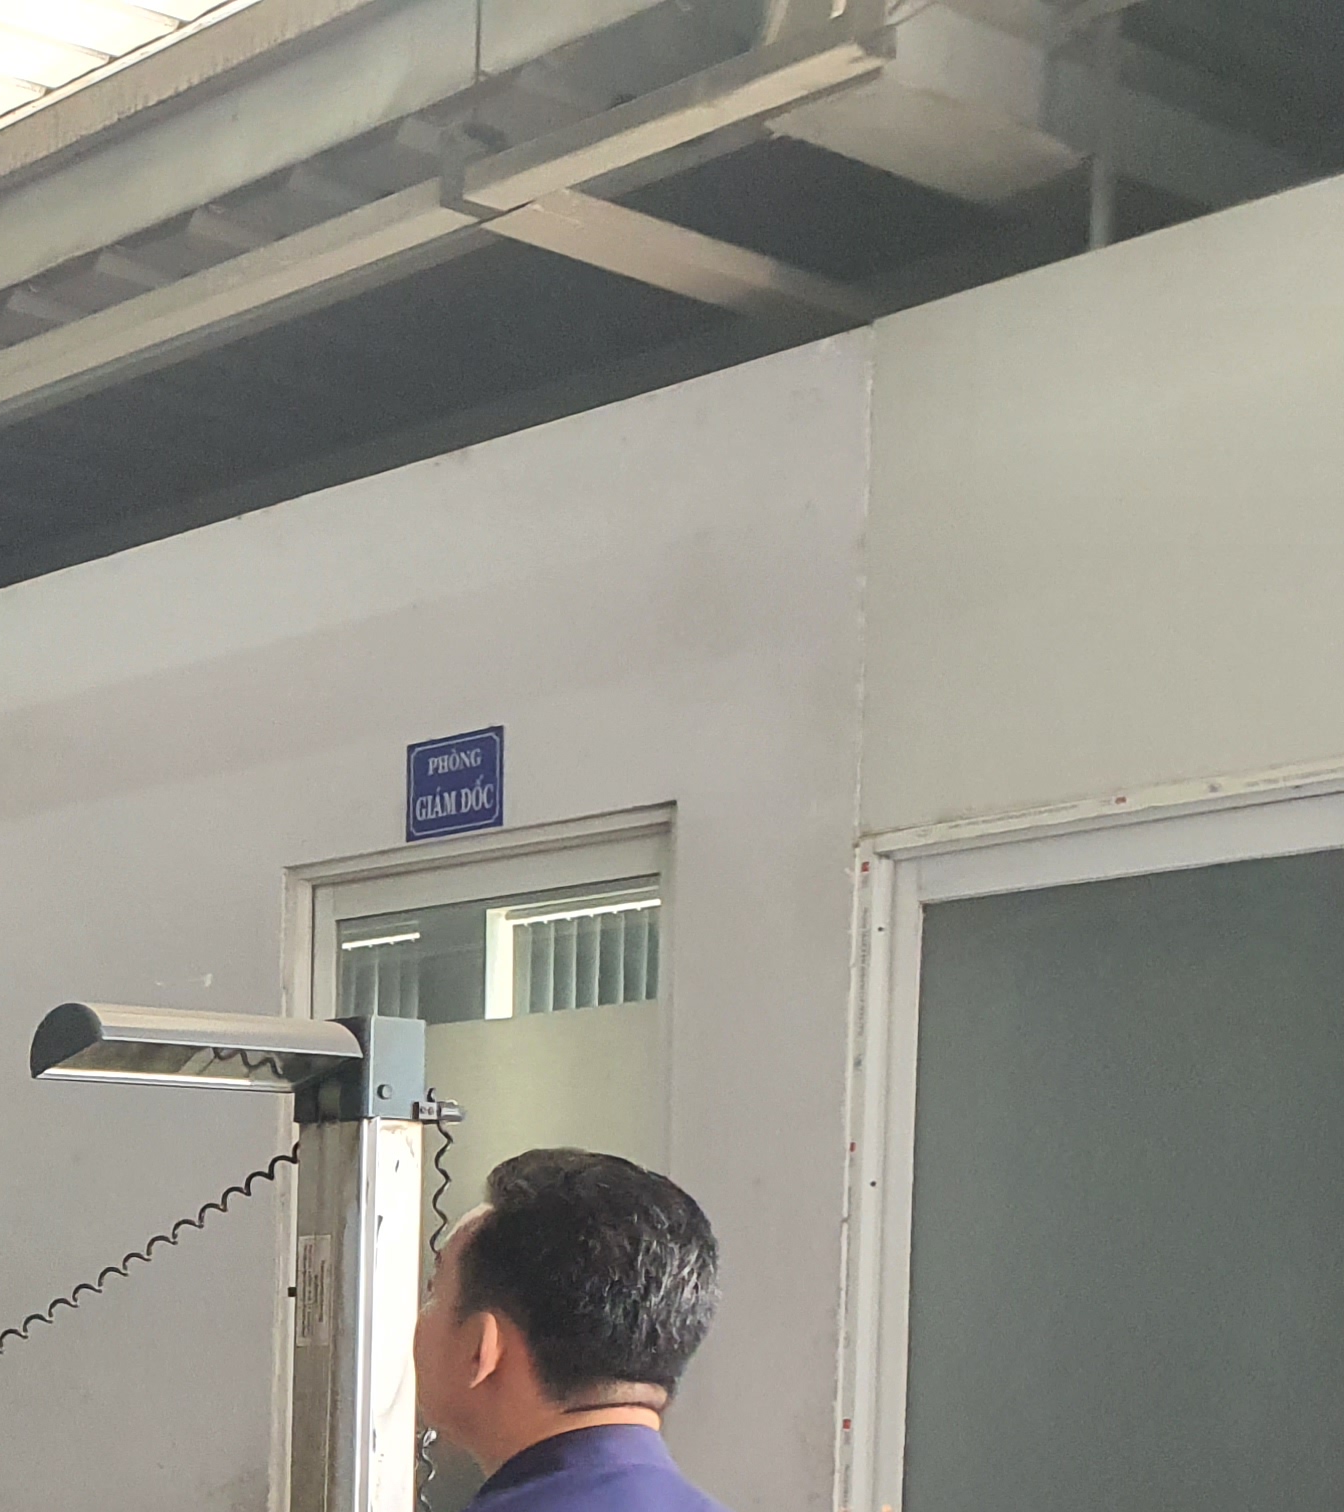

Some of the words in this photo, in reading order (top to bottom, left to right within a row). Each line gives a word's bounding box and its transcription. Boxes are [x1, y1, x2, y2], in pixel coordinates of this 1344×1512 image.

[427, 748, 481, 776] PHÒNG
[415, 786, 457, 821] GIÁM
[460, 774, 494, 814] ĐỐC
